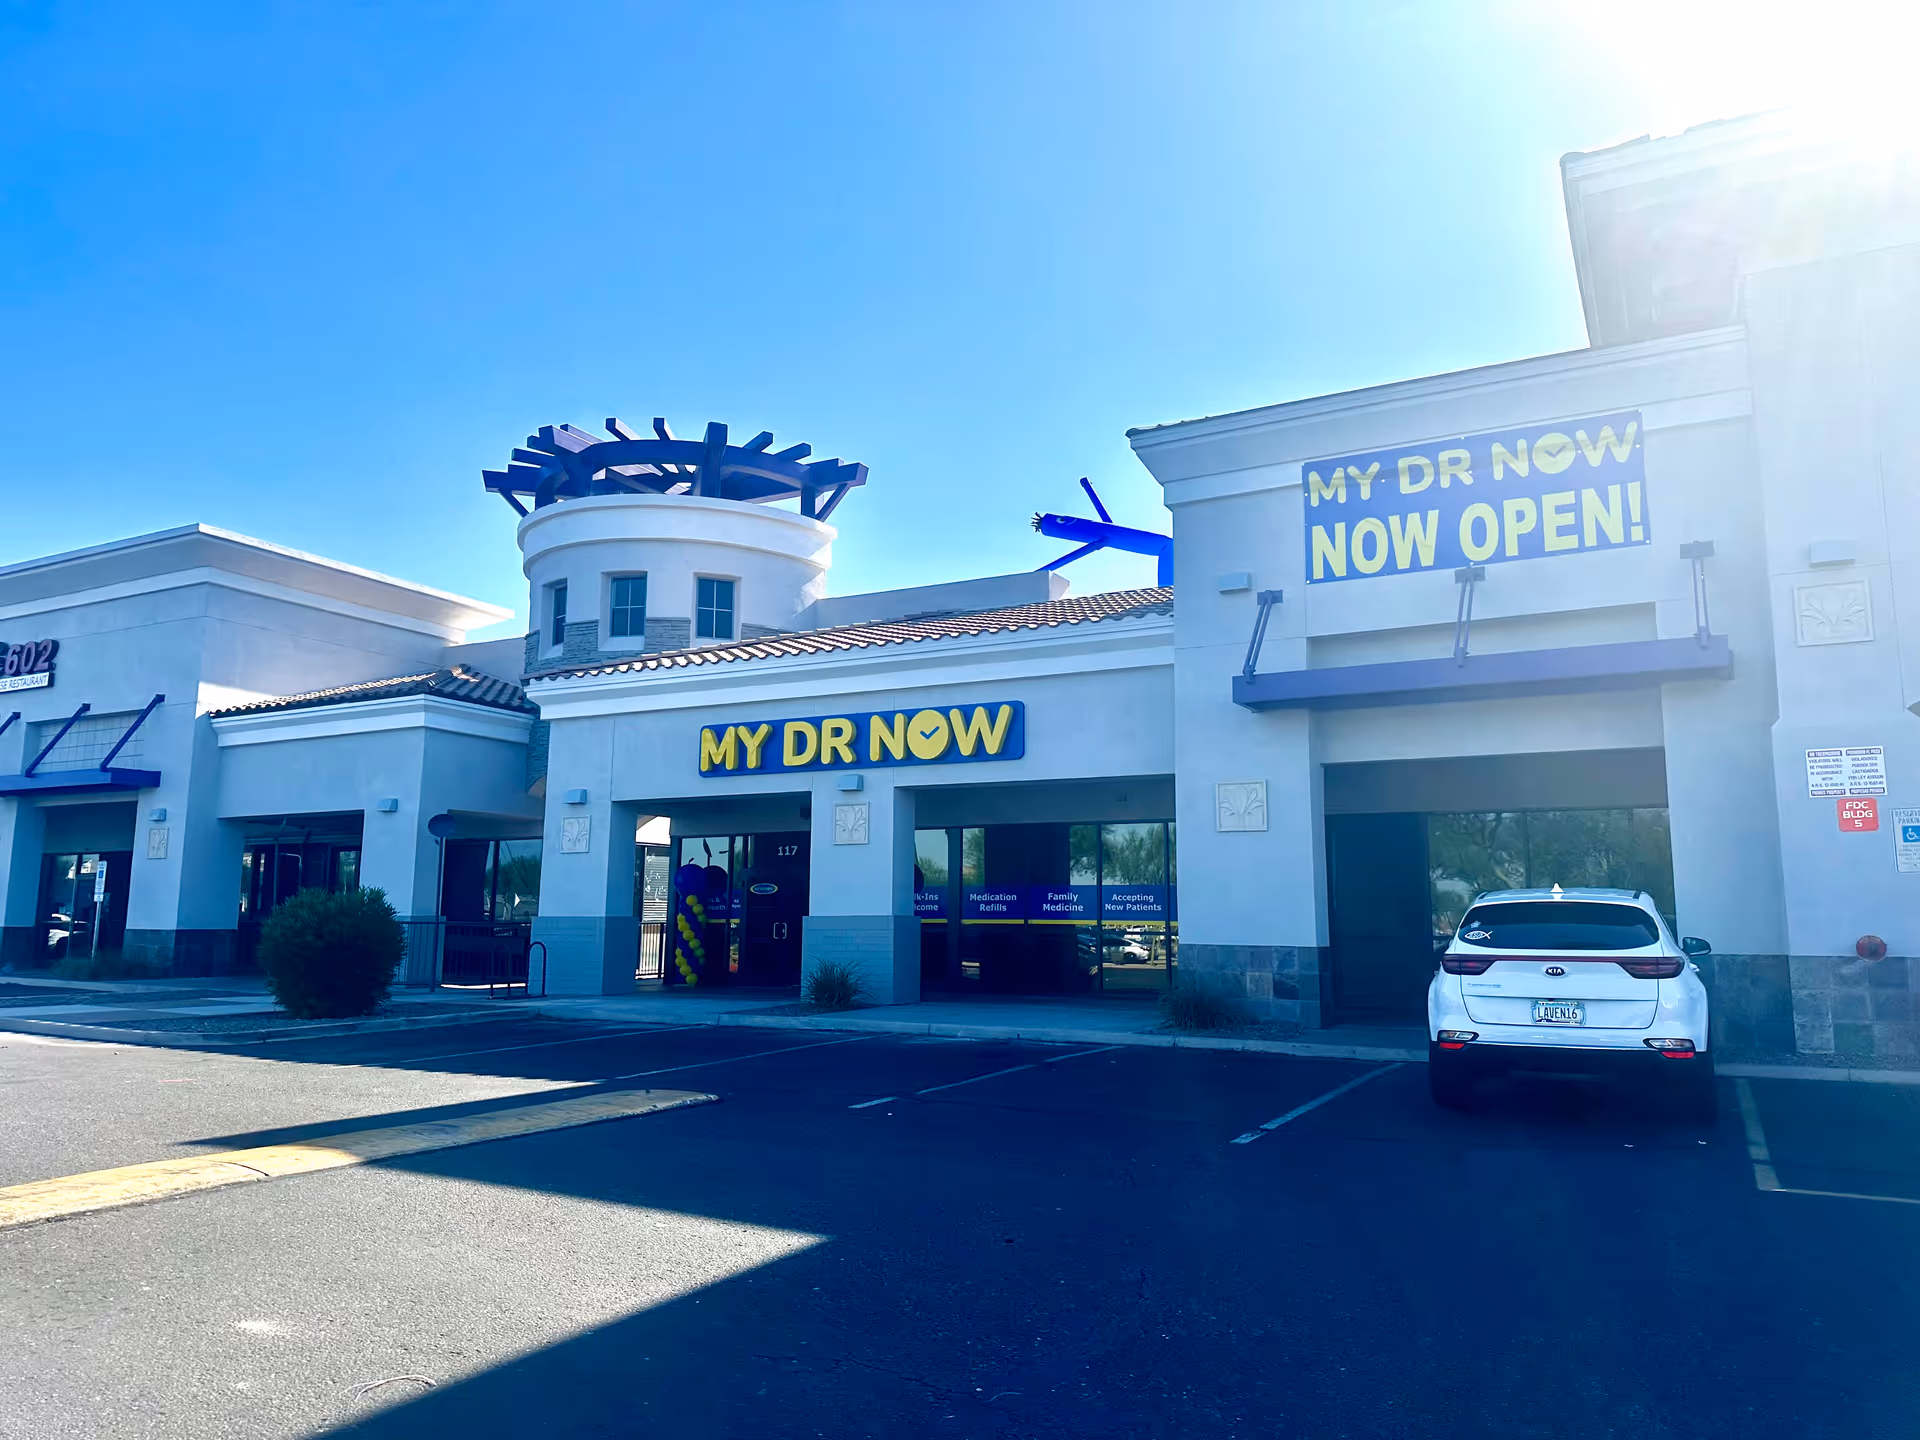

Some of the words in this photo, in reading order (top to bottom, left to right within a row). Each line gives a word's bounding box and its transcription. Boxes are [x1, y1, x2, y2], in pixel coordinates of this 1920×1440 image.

[1308, 461, 1381, 507] MY
[1397, 448, 1474, 495] DR
[1491, 421, 1638, 481] NOW
[1312, 509, 1439, 580] NOW
[1459, 481, 1644, 562] OPEN!
[4, 639, 53, 675] 602
[9, 675, 48, 688] RESTAURANT
[700, 723, 773, 772] MY
[783, 717, 857, 767] DR
[869, 703, 1014, 762] NOW
[1845, 801, 1869, 809] FDC
[1842, 810, 1873, 818] BLDG
[1854, 819, 1863, 827] 5
[777, 846, 798, 856] 117
[969, 893, 1017, 901] Medication
[1047, 892, 1079, 902] Family
[1111, 893, 1154, 903] Accepting
[979, 904, 1007, 912] Refills
[1537, 1006, 1578, 1019] LAVEN16
